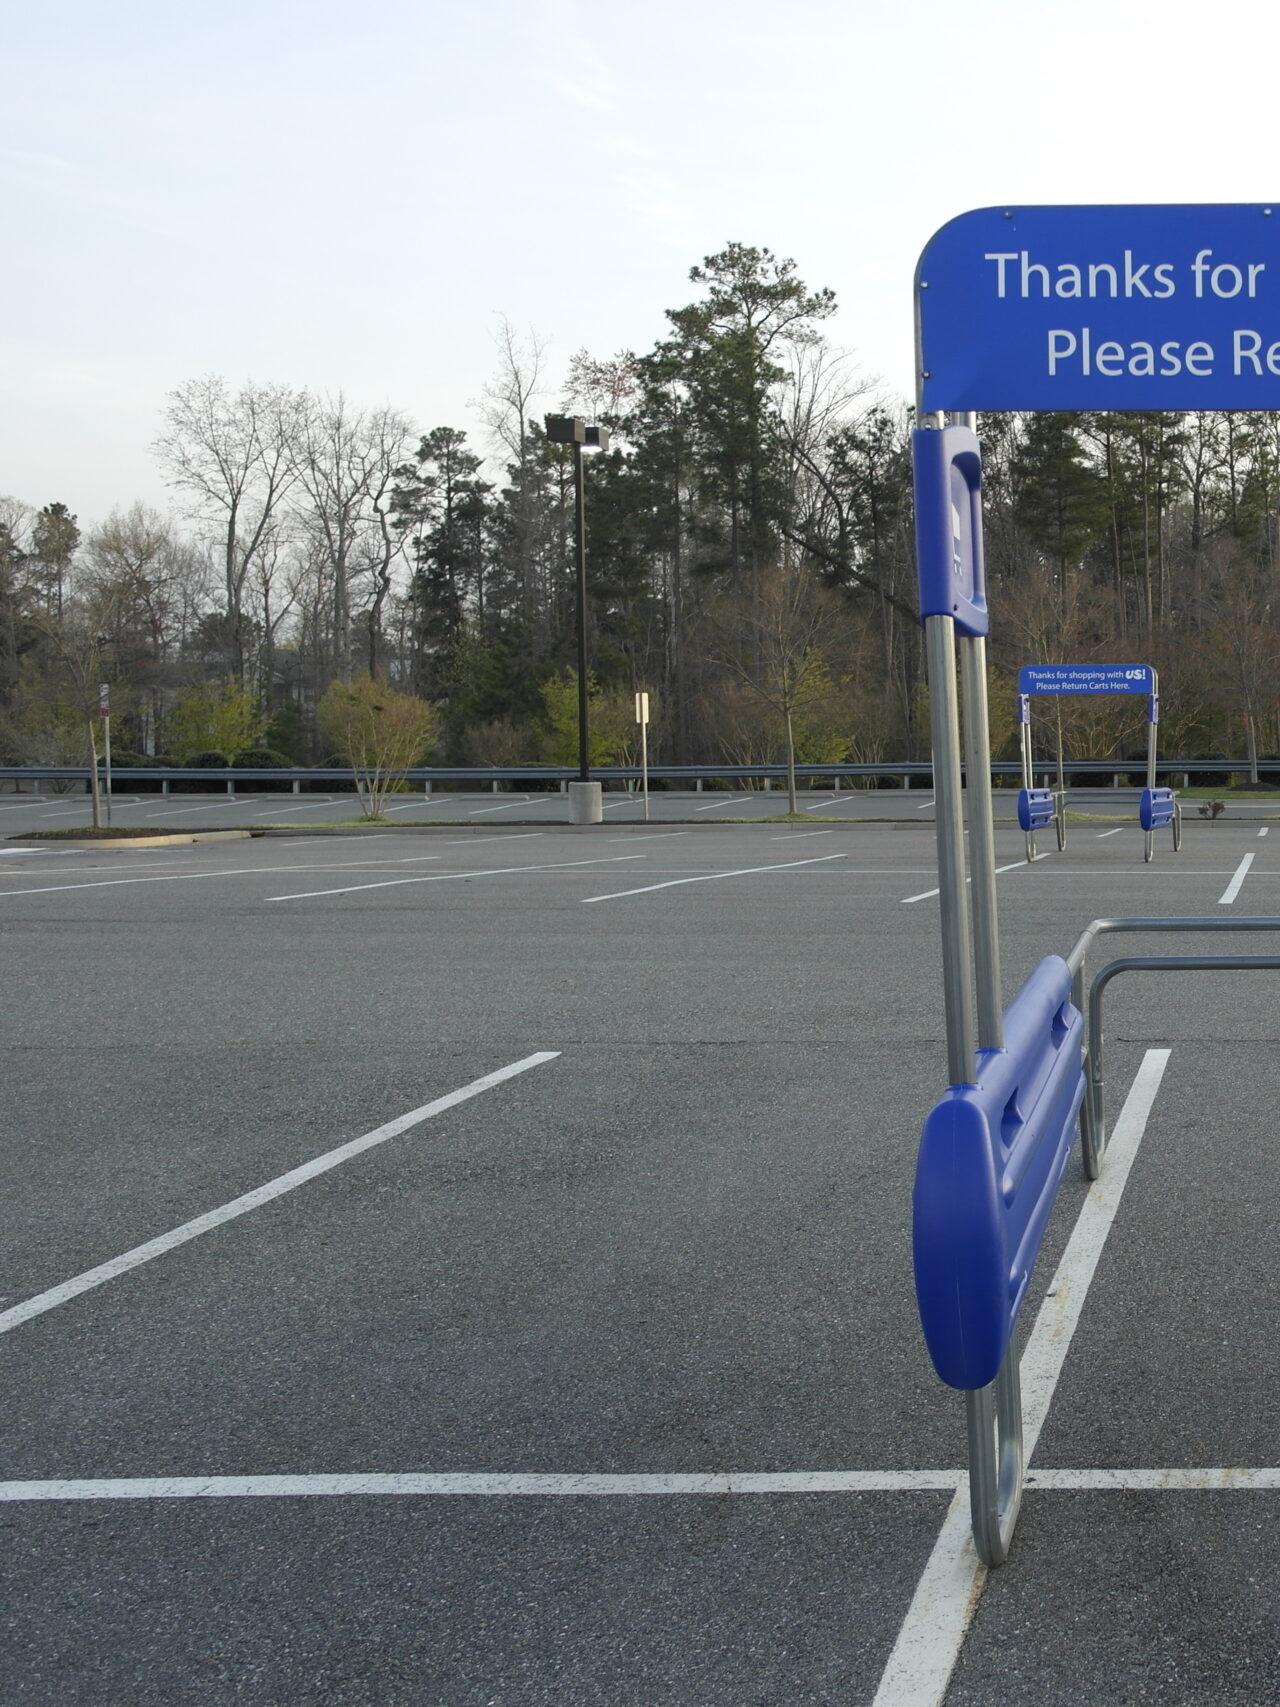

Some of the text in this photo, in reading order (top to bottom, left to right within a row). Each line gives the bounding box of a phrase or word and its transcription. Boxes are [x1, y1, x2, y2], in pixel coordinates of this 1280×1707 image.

[984, 250, 1176, 298] Thanks
[1190, 249, 1266, 298] for
[1048, 328, 1215, 376] Please
[1028, 669, 1146, 680] Thanks for shopping with US!
[1036, 682, 1130, 690] Please Return Carts Here.
